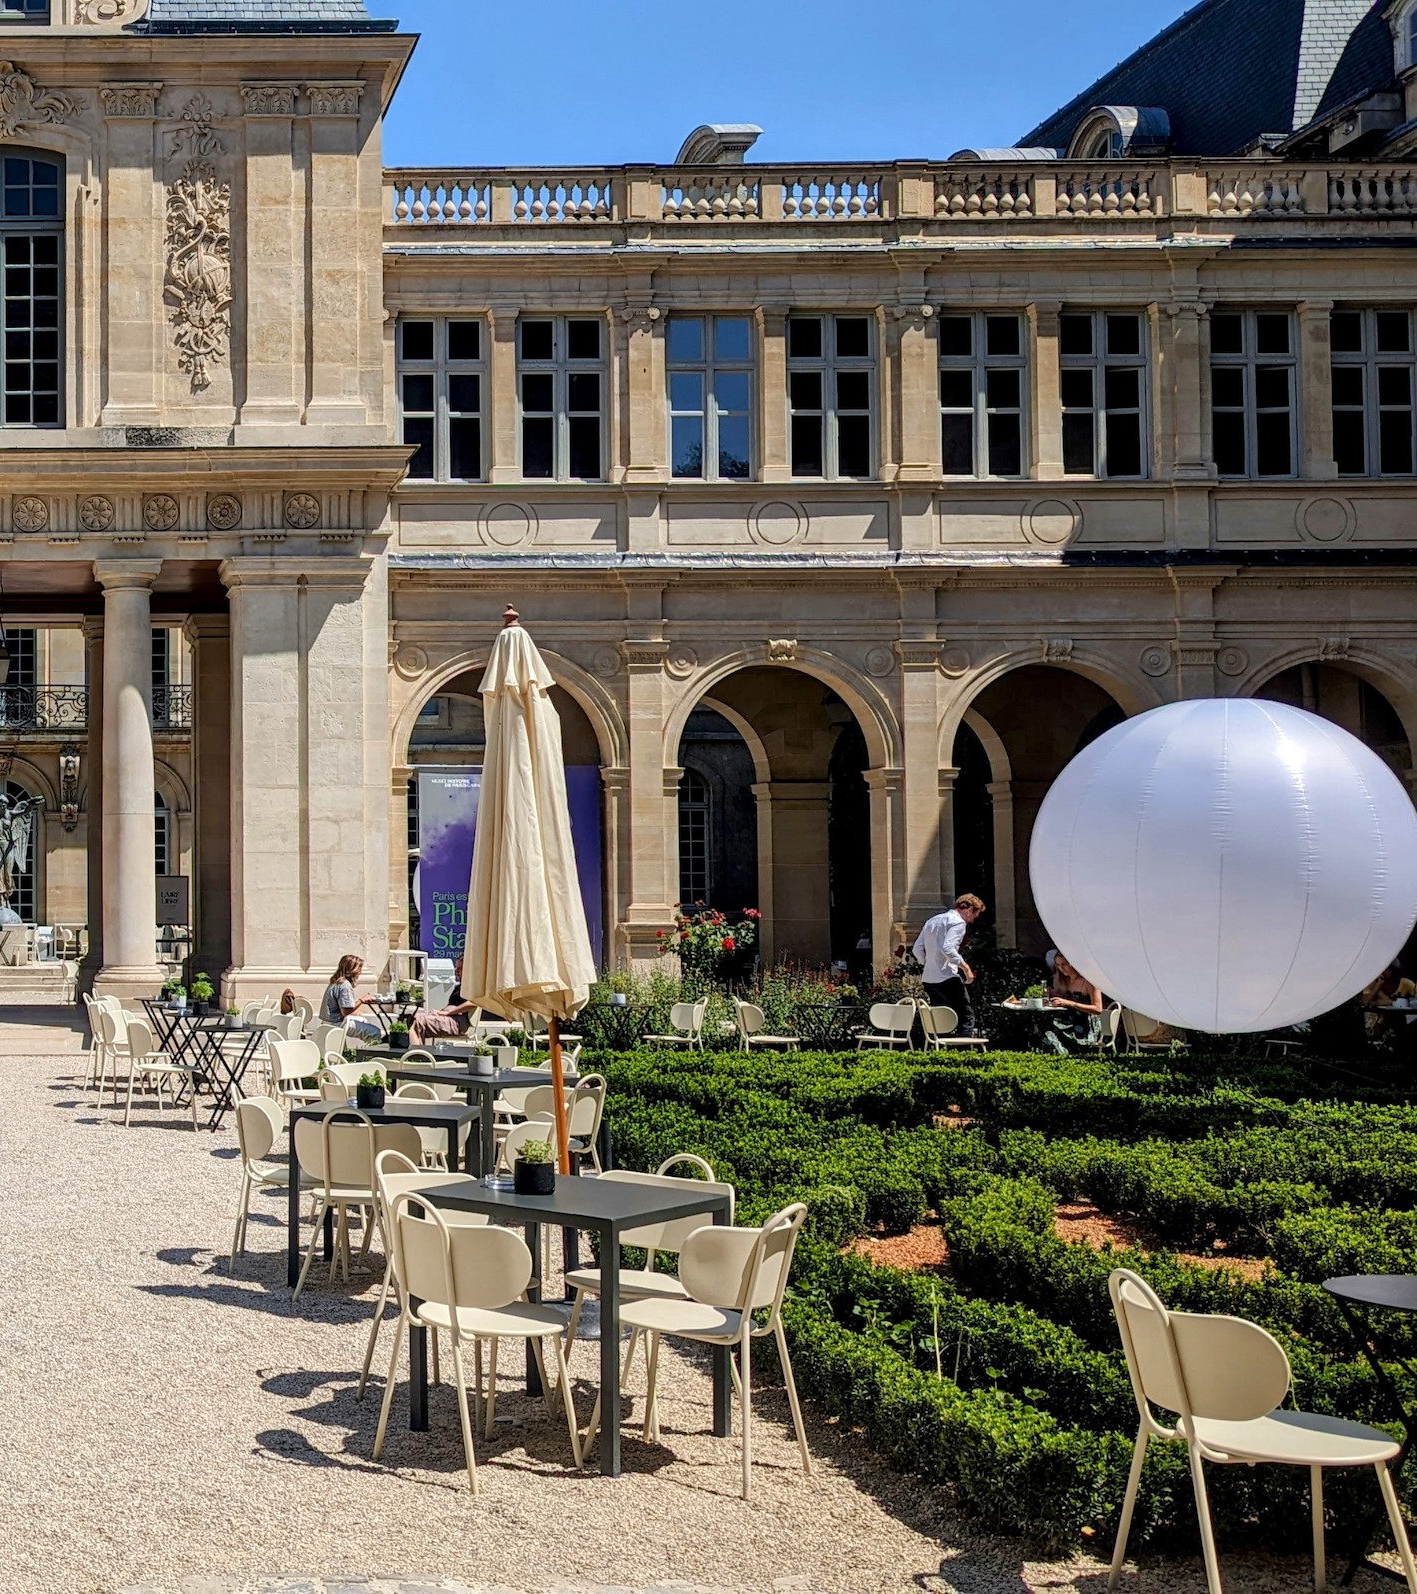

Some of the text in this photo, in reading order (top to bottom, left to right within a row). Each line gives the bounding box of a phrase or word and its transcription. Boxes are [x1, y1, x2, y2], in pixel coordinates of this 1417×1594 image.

[432, 891, 468, 901] Paris es
[432, 901, 467, 926] Ph
[432, 925, 466, 949] Sta
[433, 949, 445, 958] 29
